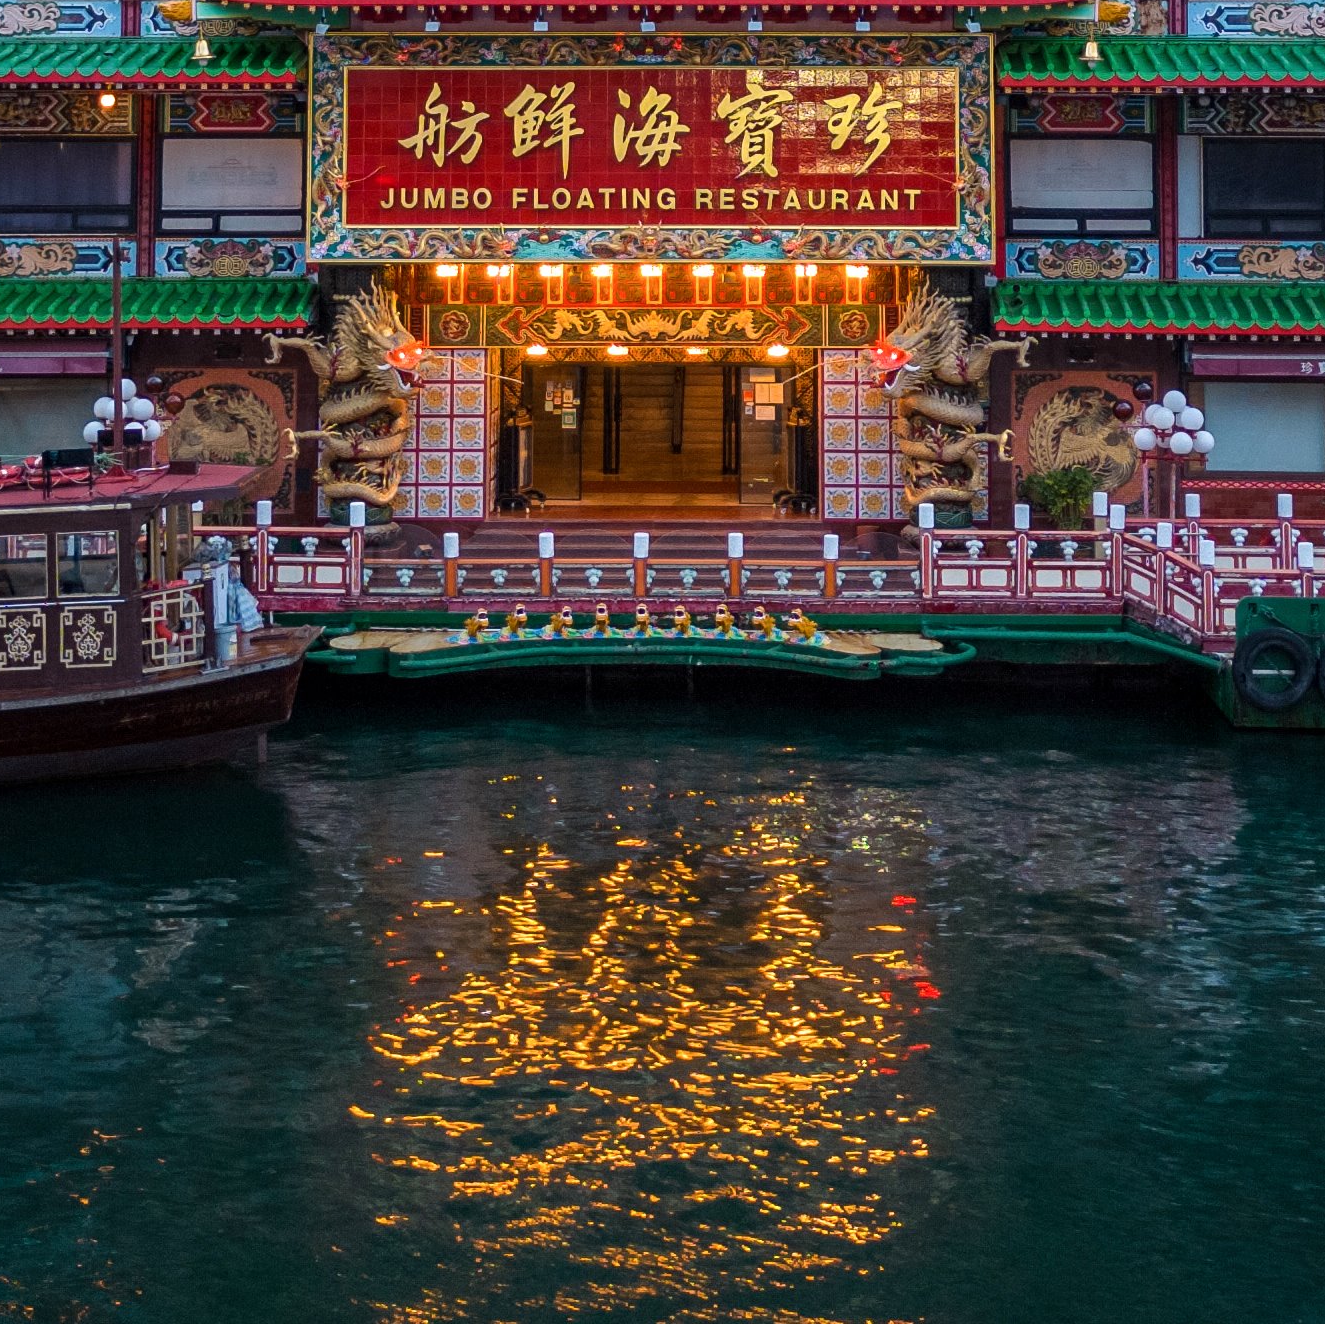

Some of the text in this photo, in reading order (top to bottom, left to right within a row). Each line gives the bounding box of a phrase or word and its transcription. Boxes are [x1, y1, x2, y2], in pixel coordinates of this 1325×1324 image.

[380, 187, 923, 211] JUMBO FLOATING RESTAURANT
